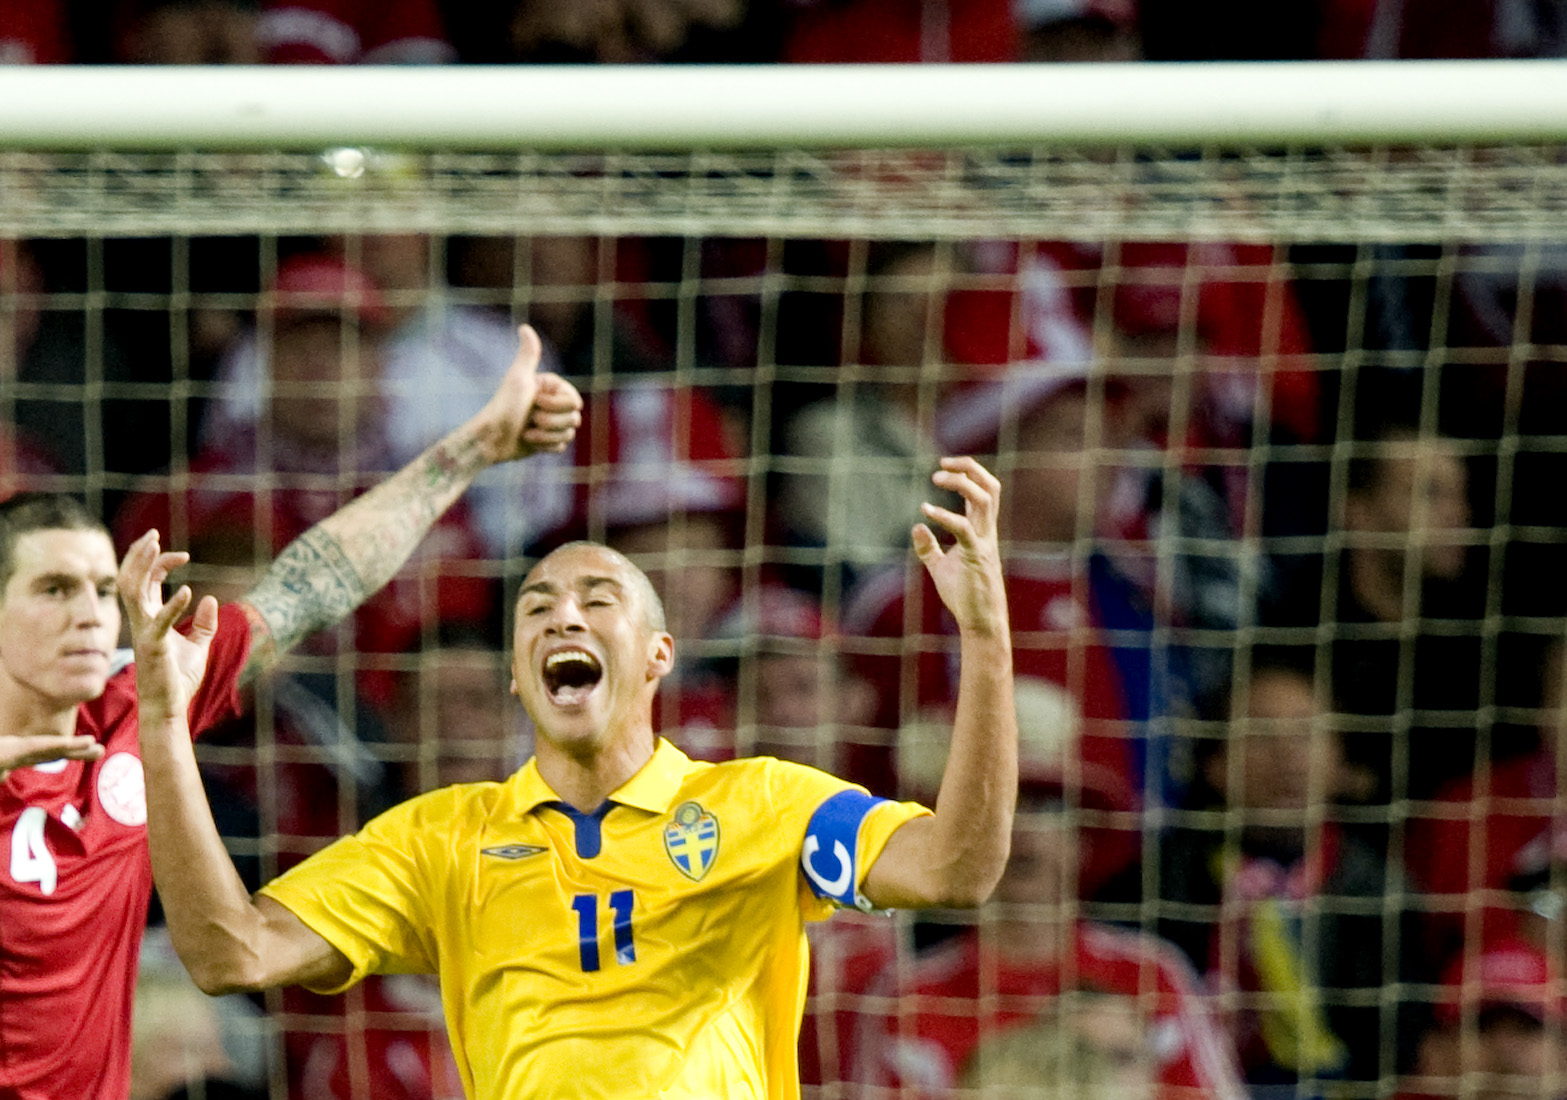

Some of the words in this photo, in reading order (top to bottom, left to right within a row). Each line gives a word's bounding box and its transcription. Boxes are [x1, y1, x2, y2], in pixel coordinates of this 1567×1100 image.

[10, 806, 58, 897] 4
[802, 834, 852, 897] C
[571, 889, 636, 973] 11
